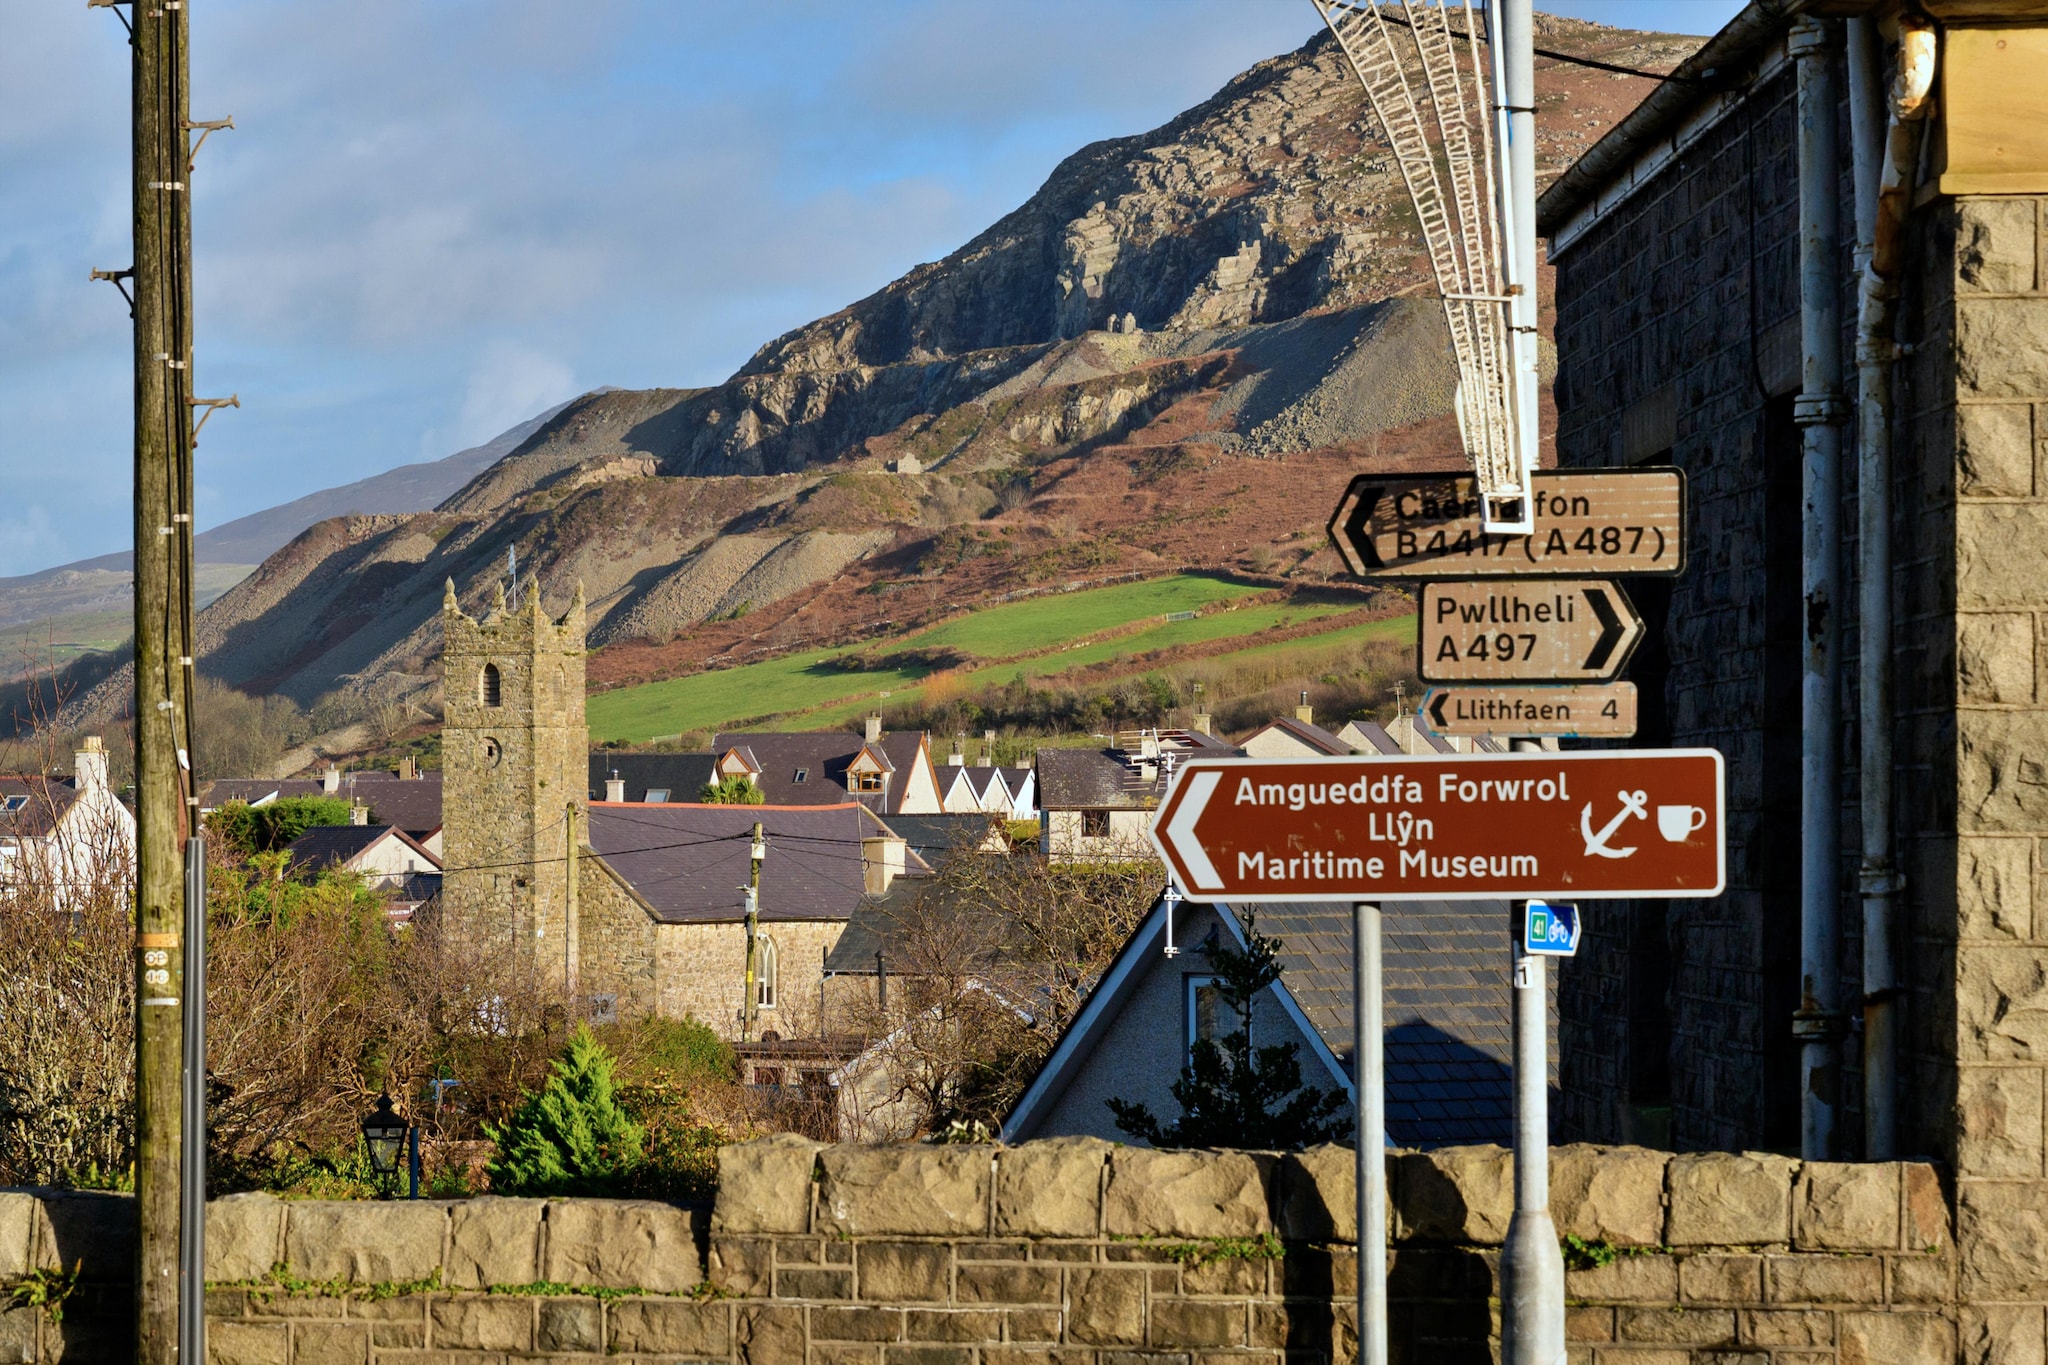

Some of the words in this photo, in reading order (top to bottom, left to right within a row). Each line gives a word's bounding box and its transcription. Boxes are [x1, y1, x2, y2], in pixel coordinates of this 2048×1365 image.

[1395, 490, 1589, 520] Caerafon
[1525, 526, 1665, 563] (A487)
[1437, 595, 1574, 623] Pwllheli
[1436, 634, 1537, 661] A497
[1456, 699, 1570, 720] Llithfaen
[1601, 699, 1619, 719] 4
[1234, 774, 1423, 811] Amgueddfa
[1439, 771, 1570, 802] Forwrol
[1369, 810, 1433, 846] Llŷn
[1238, 851, 1385, 880] Maritime
[1400, 849, 1538, 878] Museum
[1533, 919, 1545, 936] 41
